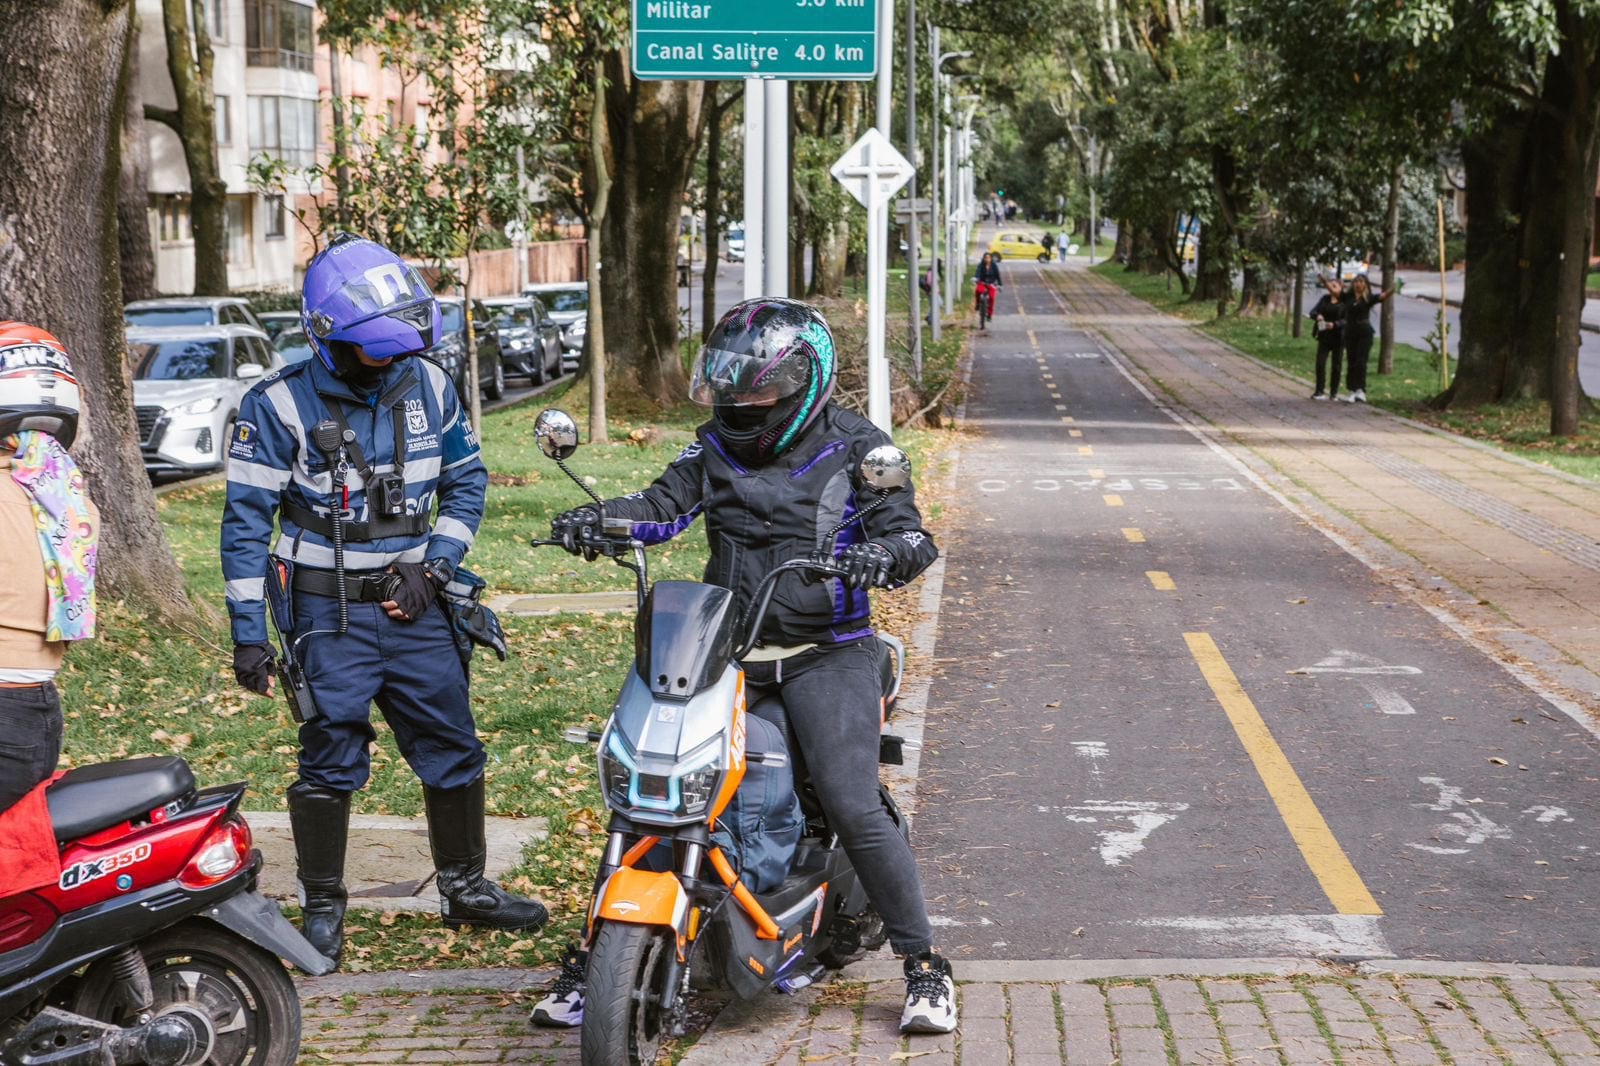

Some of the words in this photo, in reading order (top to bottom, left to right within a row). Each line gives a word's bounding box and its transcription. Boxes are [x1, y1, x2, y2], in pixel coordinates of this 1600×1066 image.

[646, 2, 711, 19] Militar
[646, 42, 704, 60] Canal
[712, 43, 779, 61] Salitre
[794, 44, 826, 61] 4.0
[834, 44, 864, 61] km
[404, 399, 423, 411] 202
